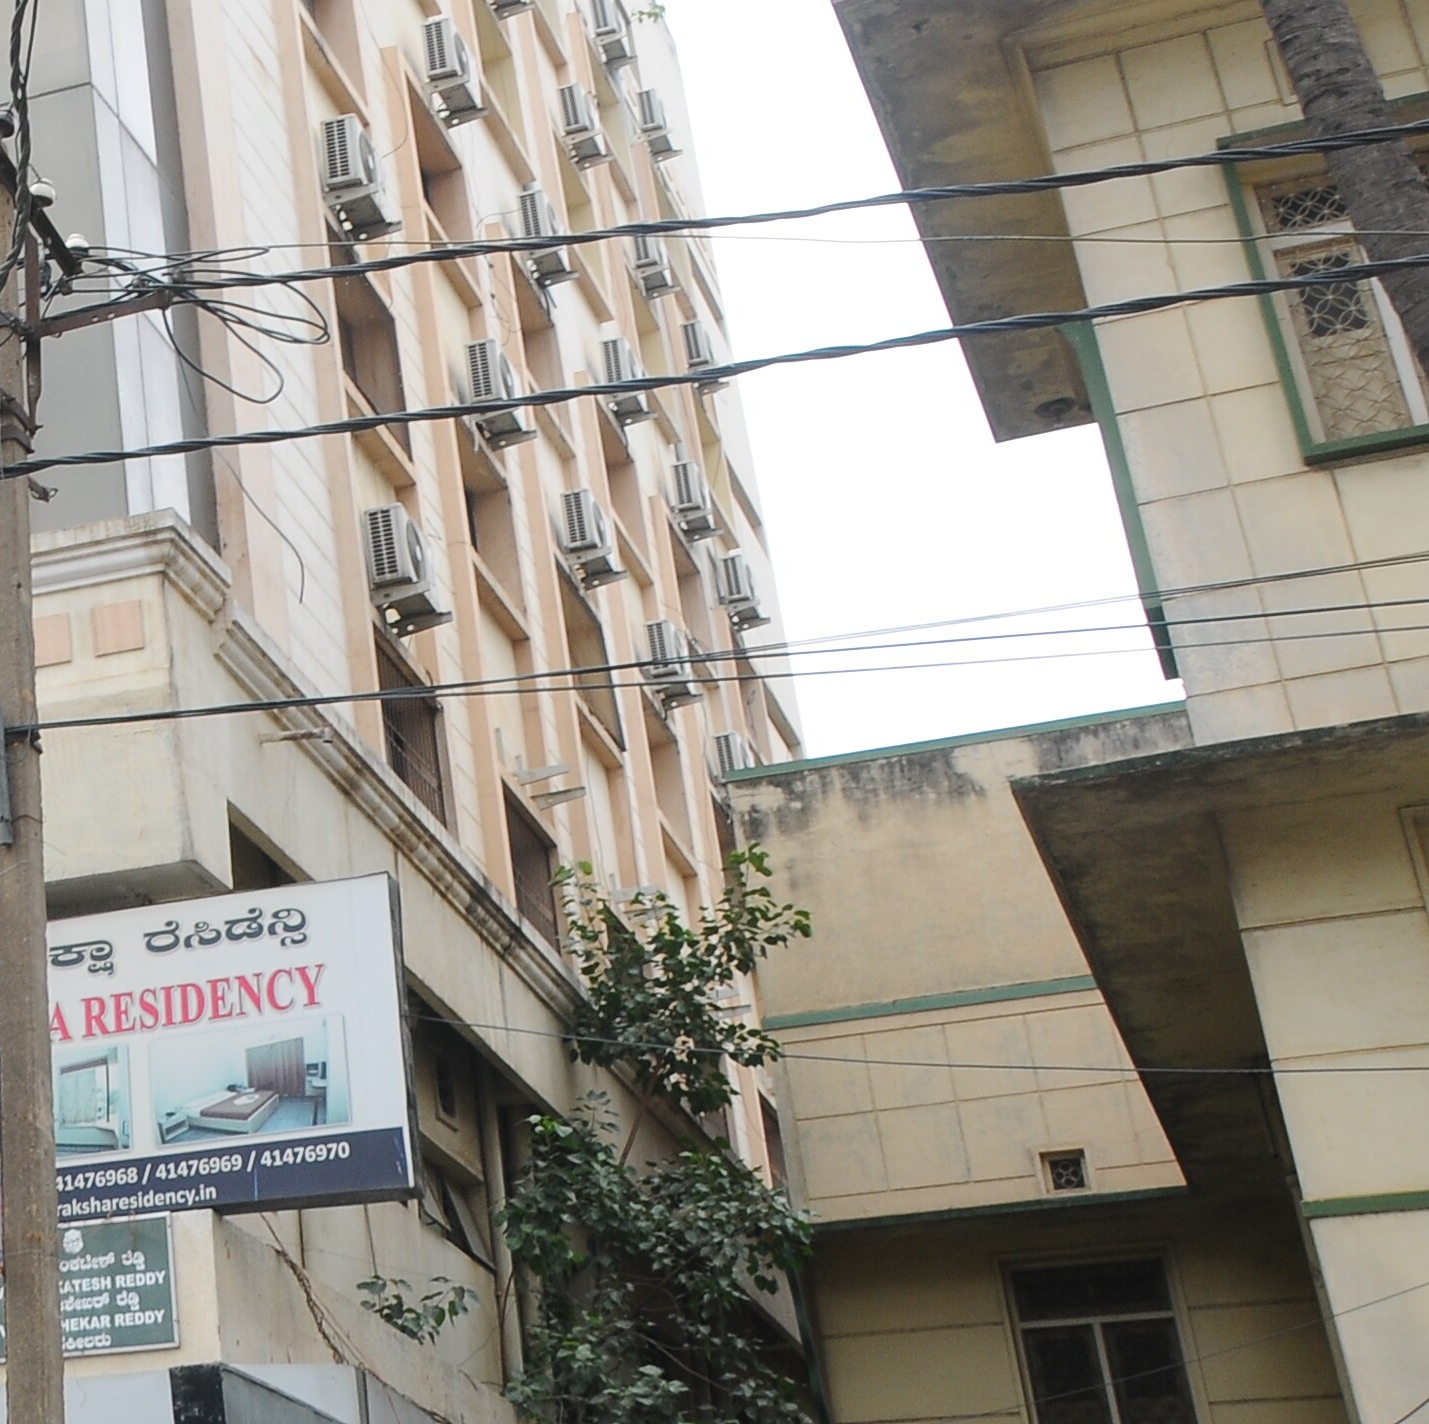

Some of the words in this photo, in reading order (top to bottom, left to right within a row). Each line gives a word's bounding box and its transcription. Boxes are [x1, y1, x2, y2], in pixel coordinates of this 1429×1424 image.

[82, 963, 325, 1037] RESIDENCY
[142, 1162, 152, 1186] /
[155, 1153, 242, 1181] 41476969
[246, 1149, 257, 1173] /
[260, 1140, 351, 1169] 41476970
[115, 1270, 166, 1288] REDDY
[114, 1309, 165, 1327] REDDY
